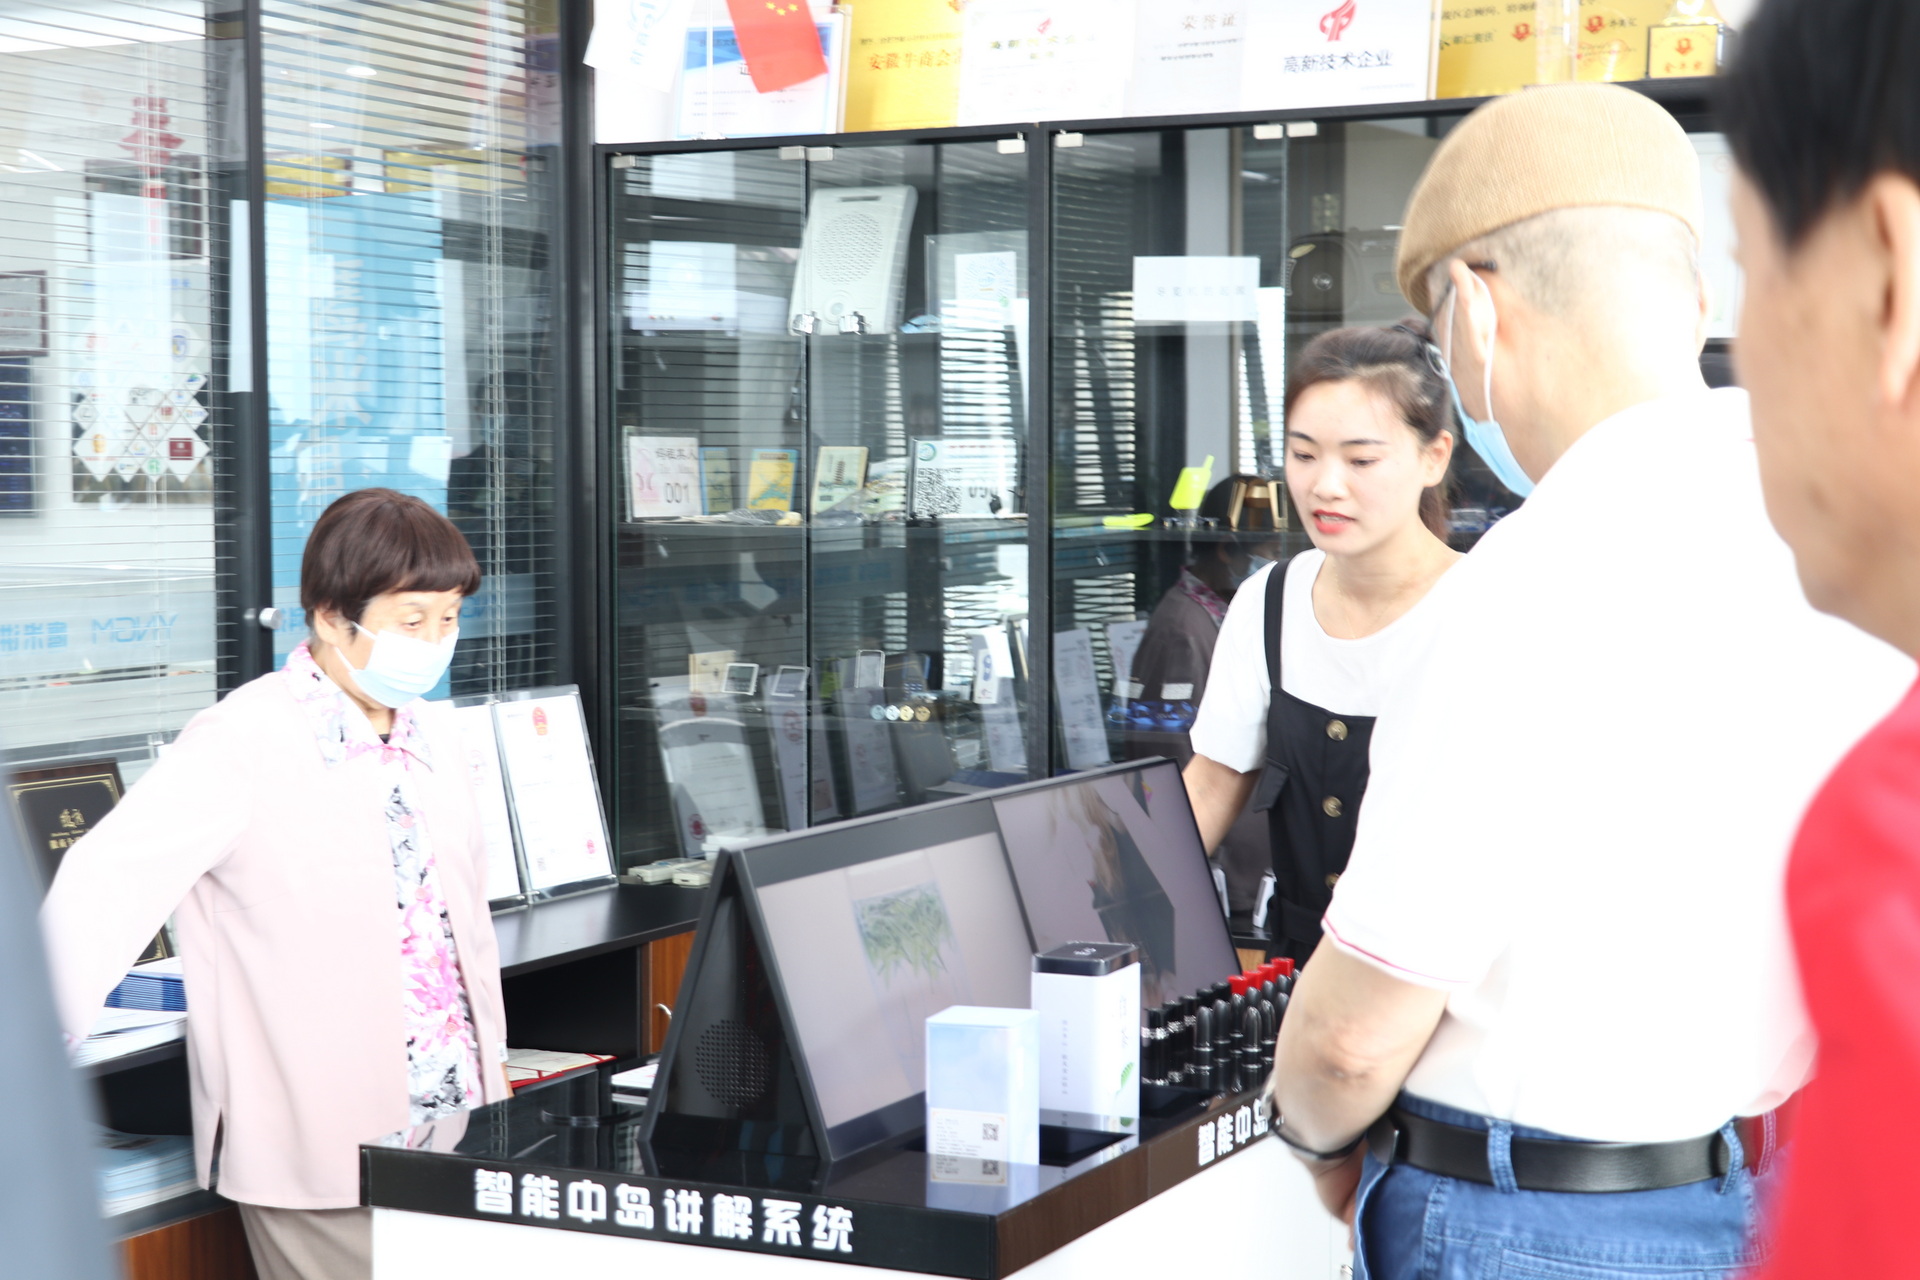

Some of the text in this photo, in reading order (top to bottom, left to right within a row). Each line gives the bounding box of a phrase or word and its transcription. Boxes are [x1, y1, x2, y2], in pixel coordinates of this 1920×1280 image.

[1282, 48, 1394, 75] 高新技术企业
[473, 1168, 855, 1253] 智能中岛讲解系统
